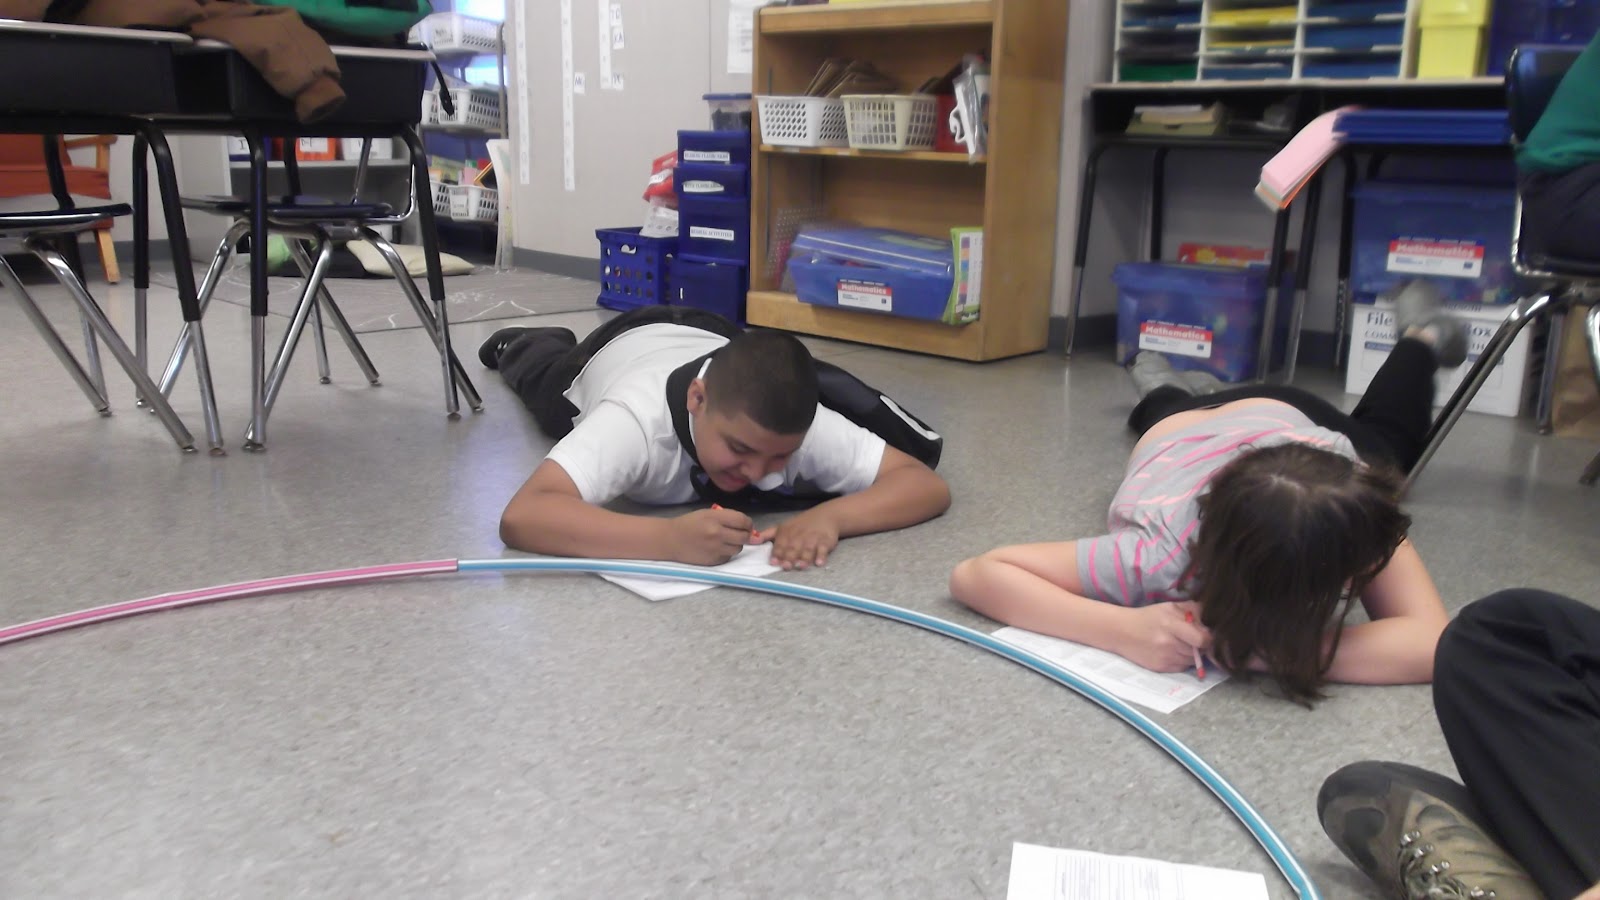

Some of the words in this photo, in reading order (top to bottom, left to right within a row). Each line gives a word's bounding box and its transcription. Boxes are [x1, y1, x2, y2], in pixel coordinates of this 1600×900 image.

[1396, 243, 1475, 259] Mathematics
[841, 283, 887, 295] Mathematics
[1366, 312, 1393, 326] File
[1145, 325, 1206, 341] Mathematics
